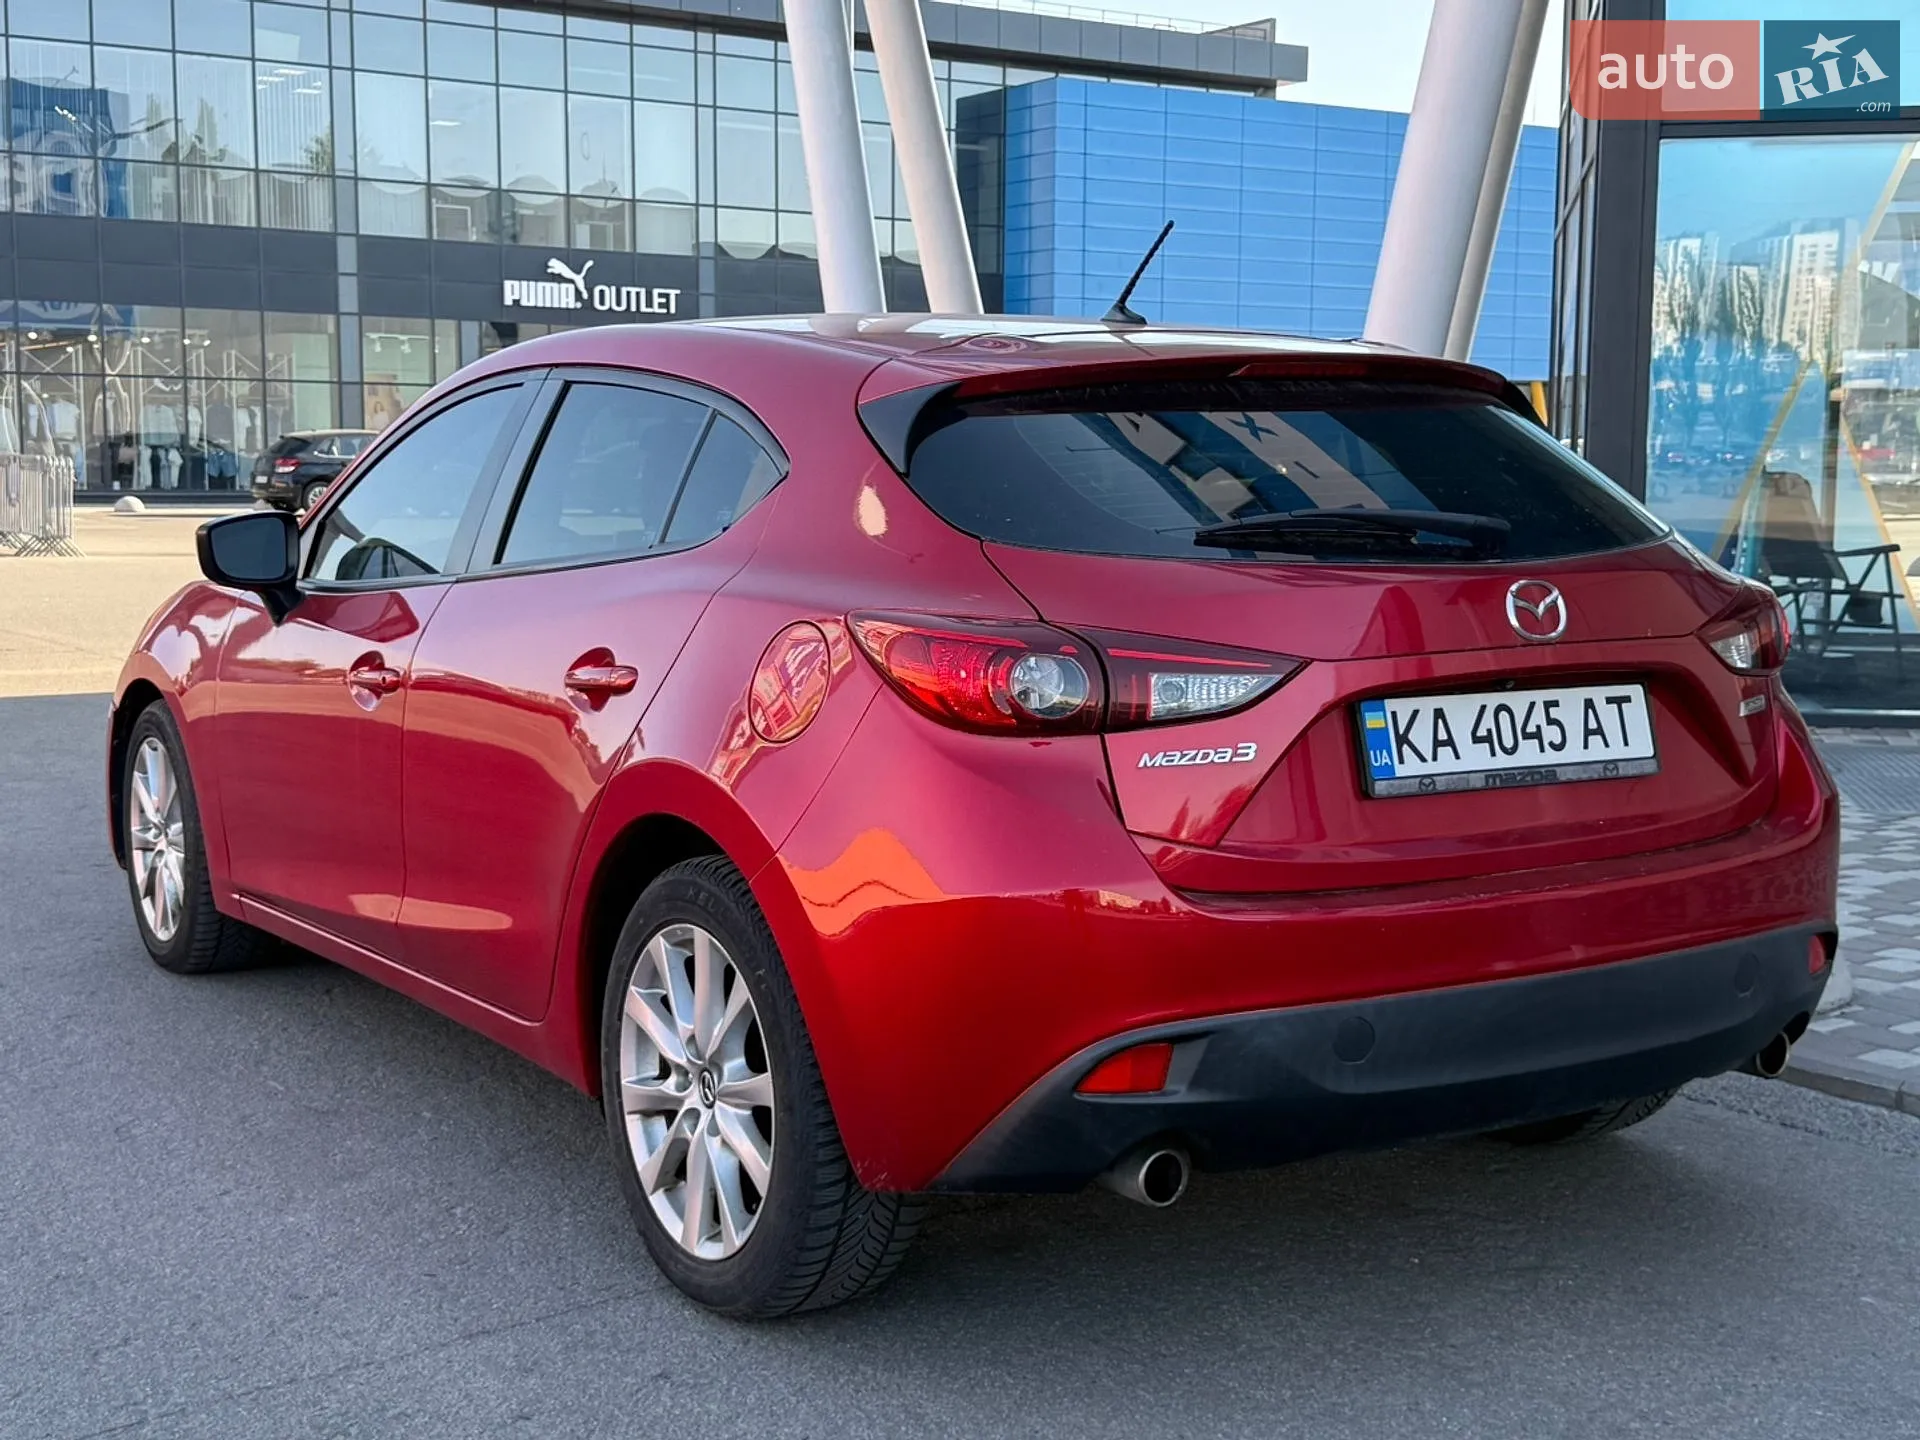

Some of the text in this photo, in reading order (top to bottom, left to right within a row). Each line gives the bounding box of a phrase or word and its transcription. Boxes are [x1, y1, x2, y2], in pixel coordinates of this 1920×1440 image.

[593, 285, 681, 314] OUTLET
[1390, 695, 1632, 765] KA 4045 AT
[1370, 750, 1392, 767] UA
